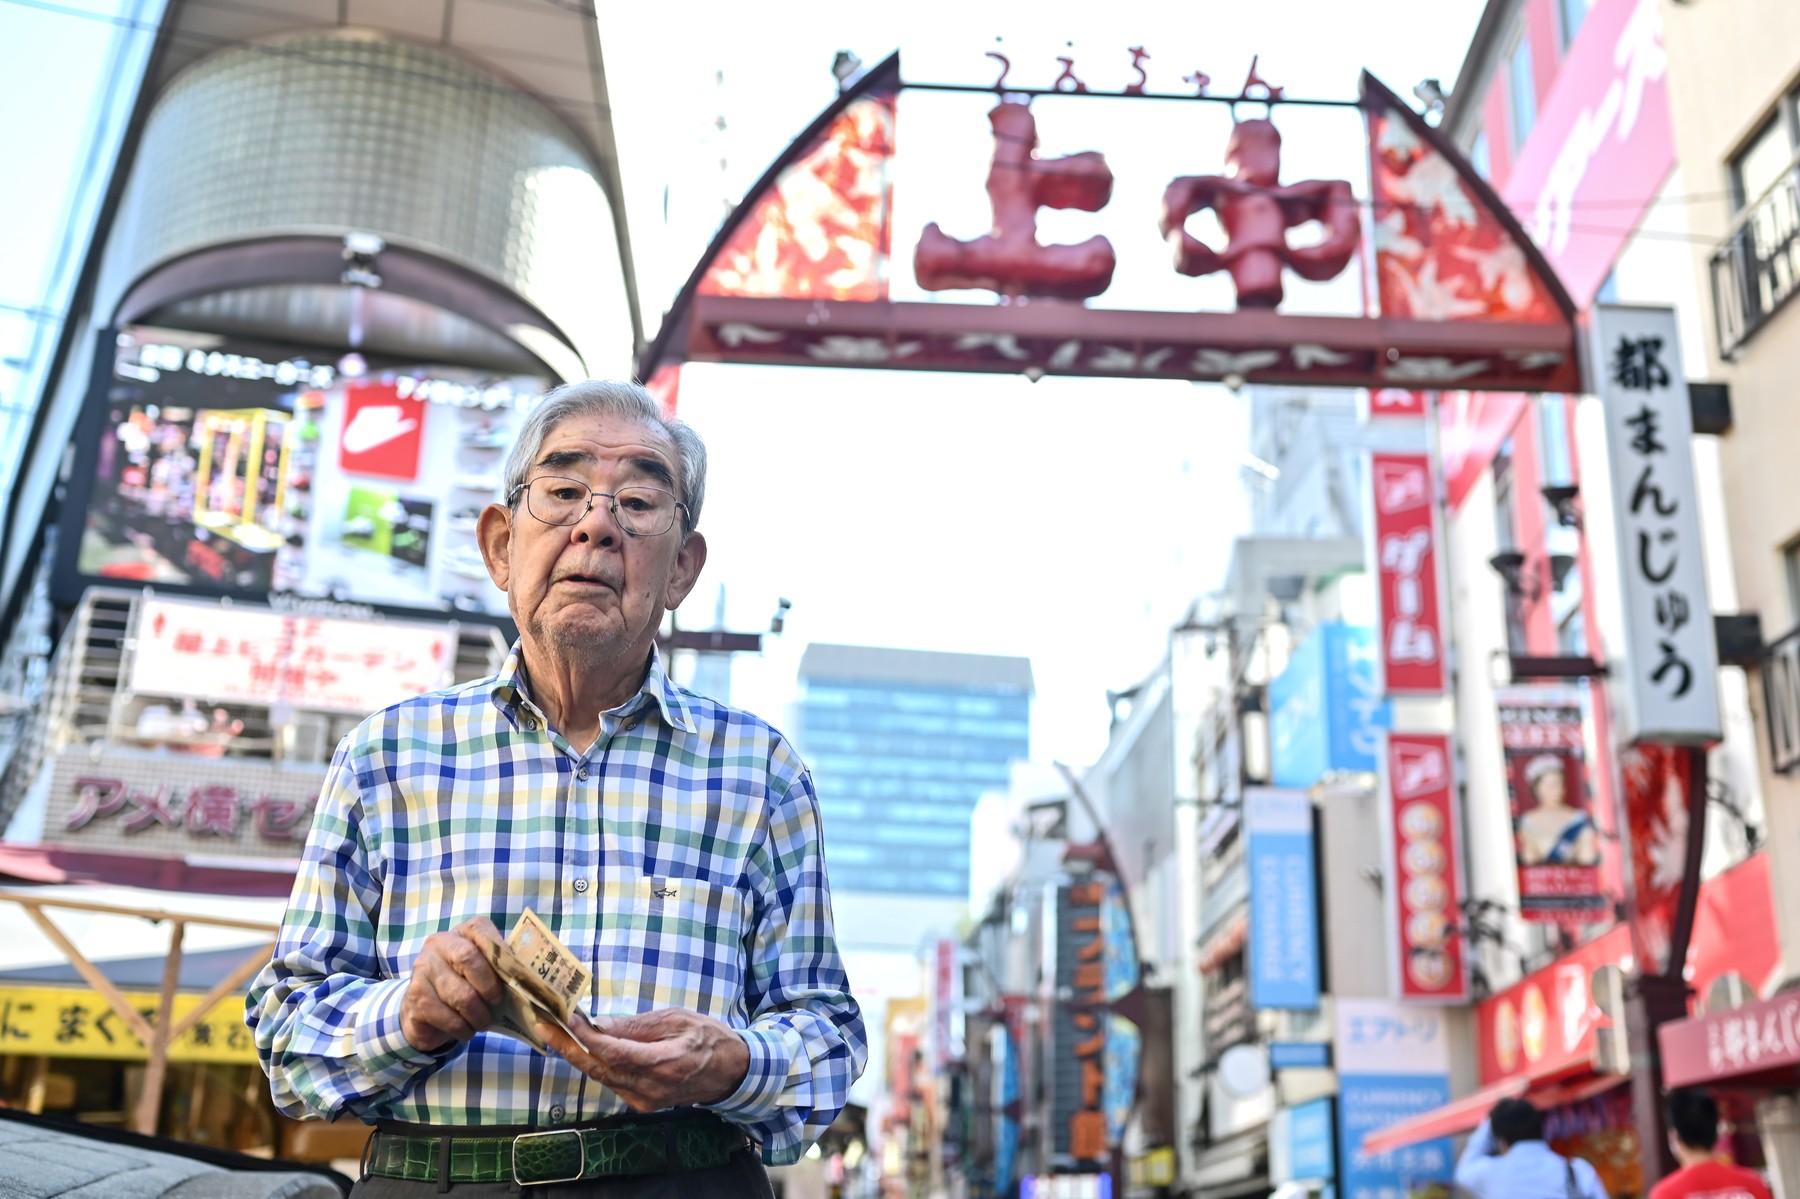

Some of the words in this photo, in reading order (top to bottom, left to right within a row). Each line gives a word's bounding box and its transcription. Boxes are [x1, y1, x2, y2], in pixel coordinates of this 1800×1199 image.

[1611, 333, 1695, 700] 都まんじゅう
[62, 775, 319, 845] アメ横セ
[1348, 1014, 1439, 1044] エアトリ
